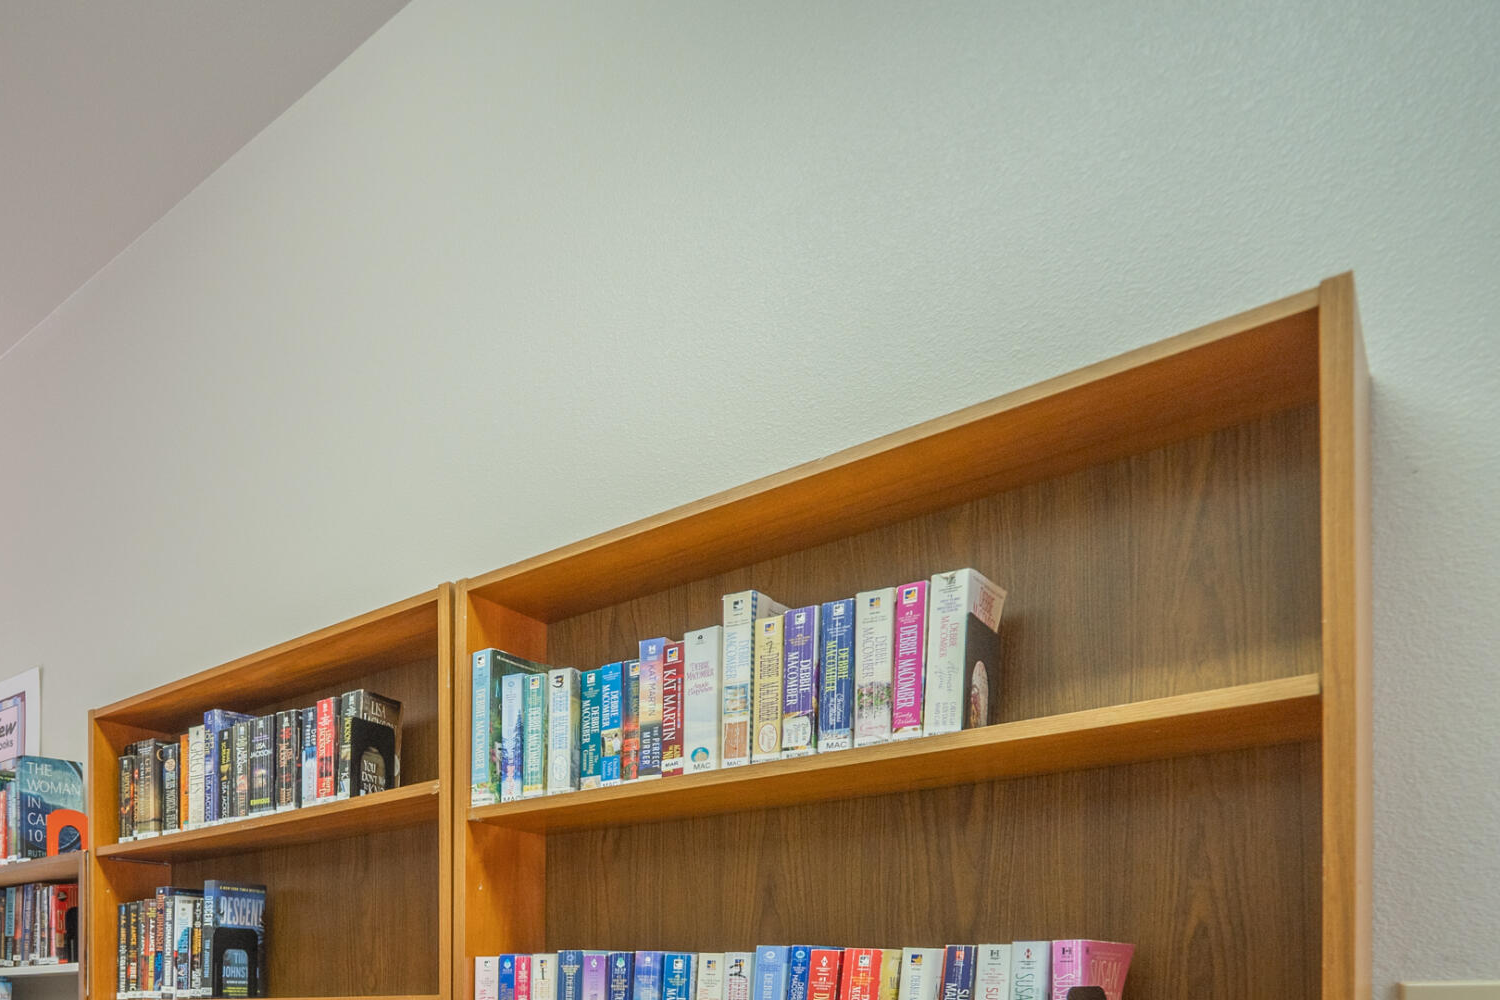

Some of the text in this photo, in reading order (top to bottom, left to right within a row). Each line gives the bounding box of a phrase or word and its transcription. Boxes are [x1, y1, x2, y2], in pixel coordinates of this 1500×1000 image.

[786, 651, 798, 706] MACOMBER
[800, 659, 811, 693] DEBBIE
[825, 640, 837, 693] MACOMBER
[837, 647, 849, 680] DEBBIE
[896, 624, 918, 710] DEBBIE MACOMBER
[371, 700, 386, 719] LISA
[601, 684, 610, 728] MACOMBER
[610, 690, 619, 718] DEBBIE
[662, 668, 677, 741] KAT MARTIN
[581, 700, 591, 744] MACOMBER
[590, 706, 600, 734] DEBBIE
[250, 749, 273, 759] JACKSON
[256, 742, 267, 751] LISA
[642, 731, 651, 766] MURDER
[651, 737, 660, 768] PERFECT
[826, 741, 845, 749] MAC
[26, 761, 52, 777] THE
[363, 760, 376, 773] YOU
[26, 779, 79, 794] WOMAN
[27, 795, 41, 808] IN
[204, 896, 213, 927] DESCENT
[220, 896, 265, 926] DESCENT
